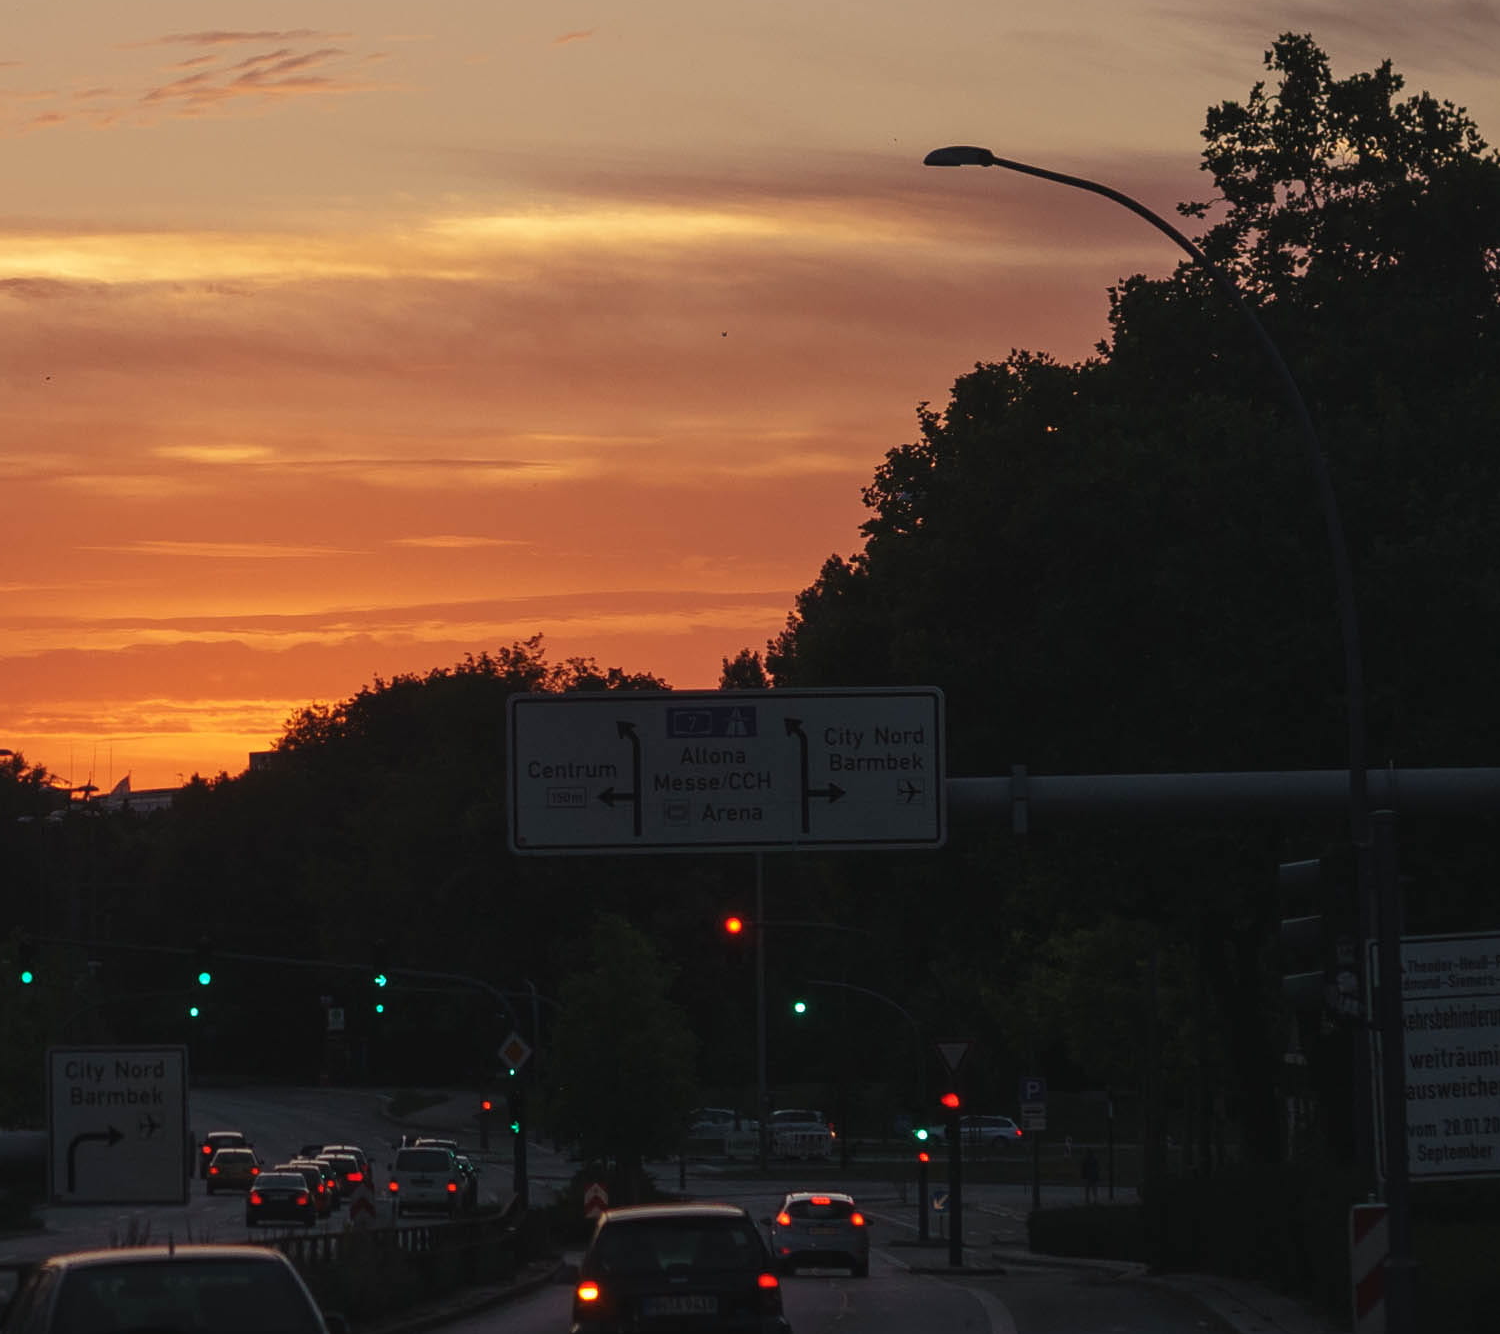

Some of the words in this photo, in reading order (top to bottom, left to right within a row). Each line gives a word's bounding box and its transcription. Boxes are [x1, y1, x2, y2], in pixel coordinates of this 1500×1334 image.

[687, 714, 698, 732] 7
[823, 727, 865, 750] City
[874, 724, 926, 746] Nord
[679, 746, 747, 766] Altona
[829, 749, 925, 773] Barmbek
[527, 761, 619, 781] Centrum
[653, 771, 772, 793] Messe/CCH
[700, 803, 764, 823] Arena
[65, 1060, 105, 1083] City
[115, 1060, 165, 1079] Nord
[70, 1086, 164, 1107] Barmbek
[1416, 1142, 1495, 1165] September
